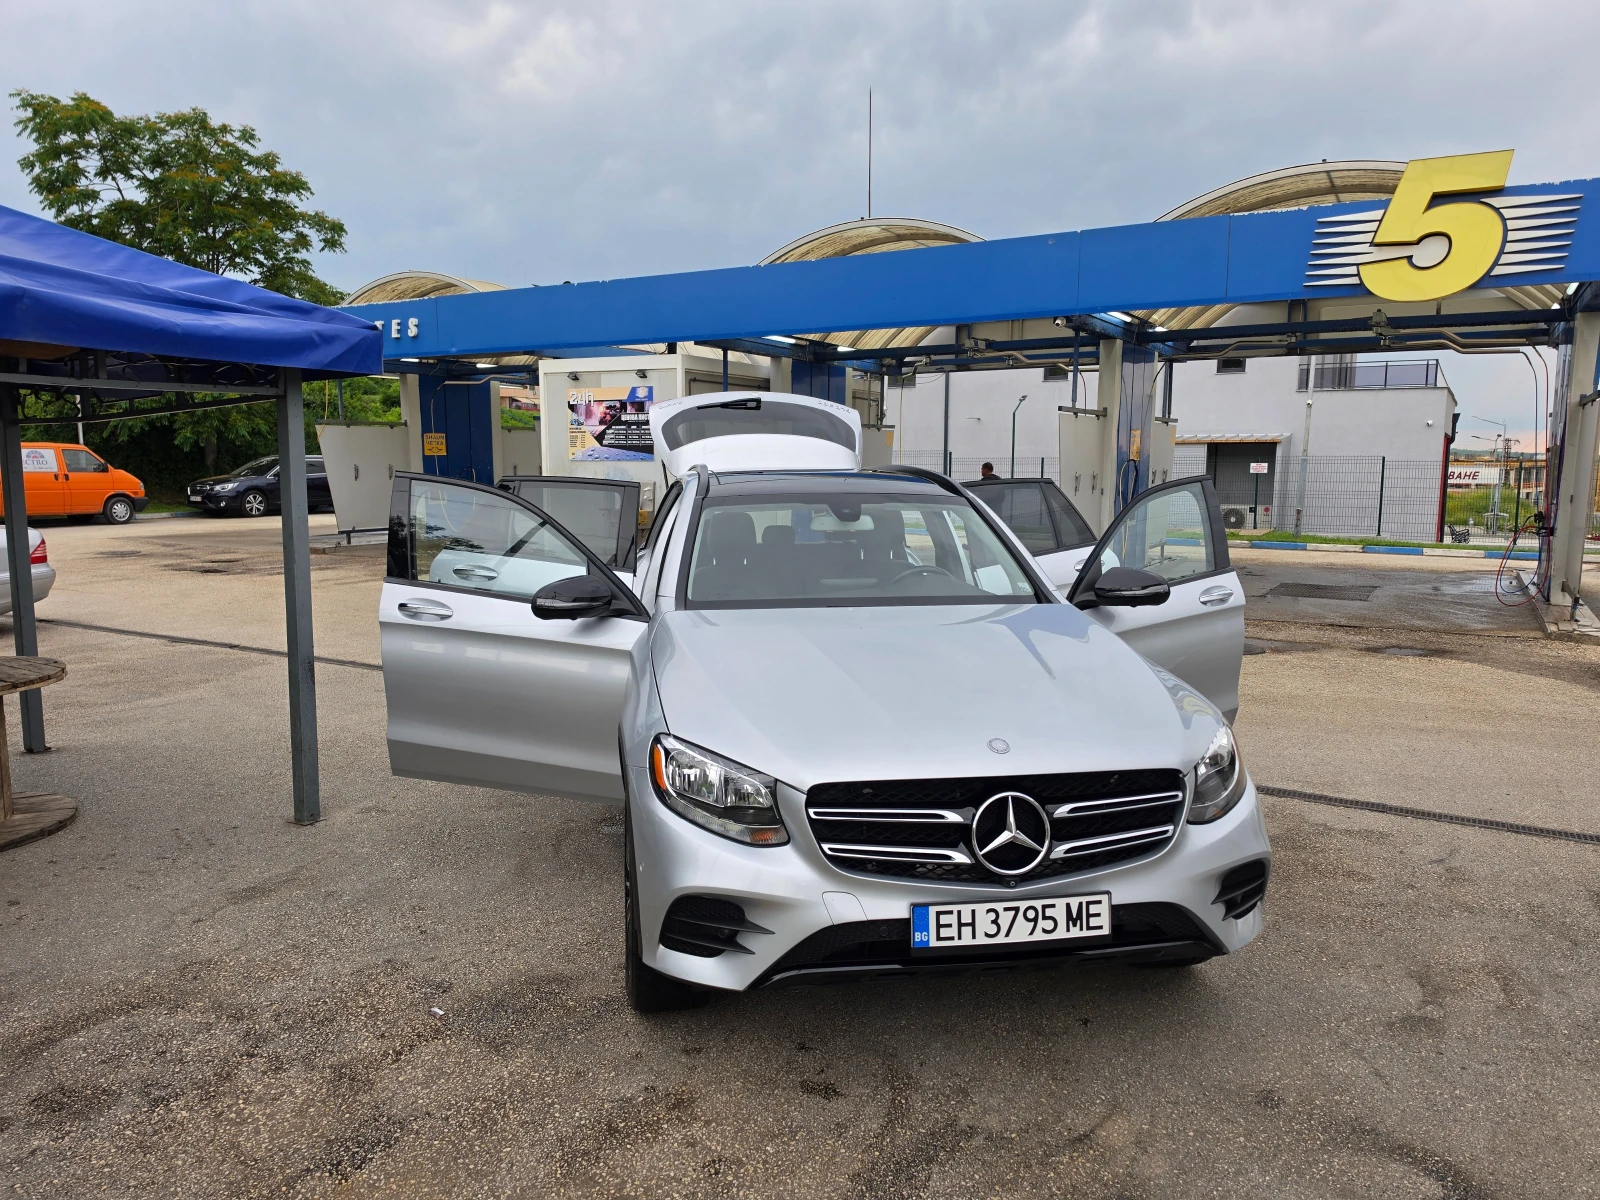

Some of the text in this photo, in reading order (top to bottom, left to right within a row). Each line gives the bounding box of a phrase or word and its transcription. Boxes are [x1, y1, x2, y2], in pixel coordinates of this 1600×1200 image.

[1357, 149, 1515, 302] 5
[569, 389, 594, 407] 24h
[934, 899, 1104, 942] EH 3795 ME
[914, 931, 928, 942] BG
